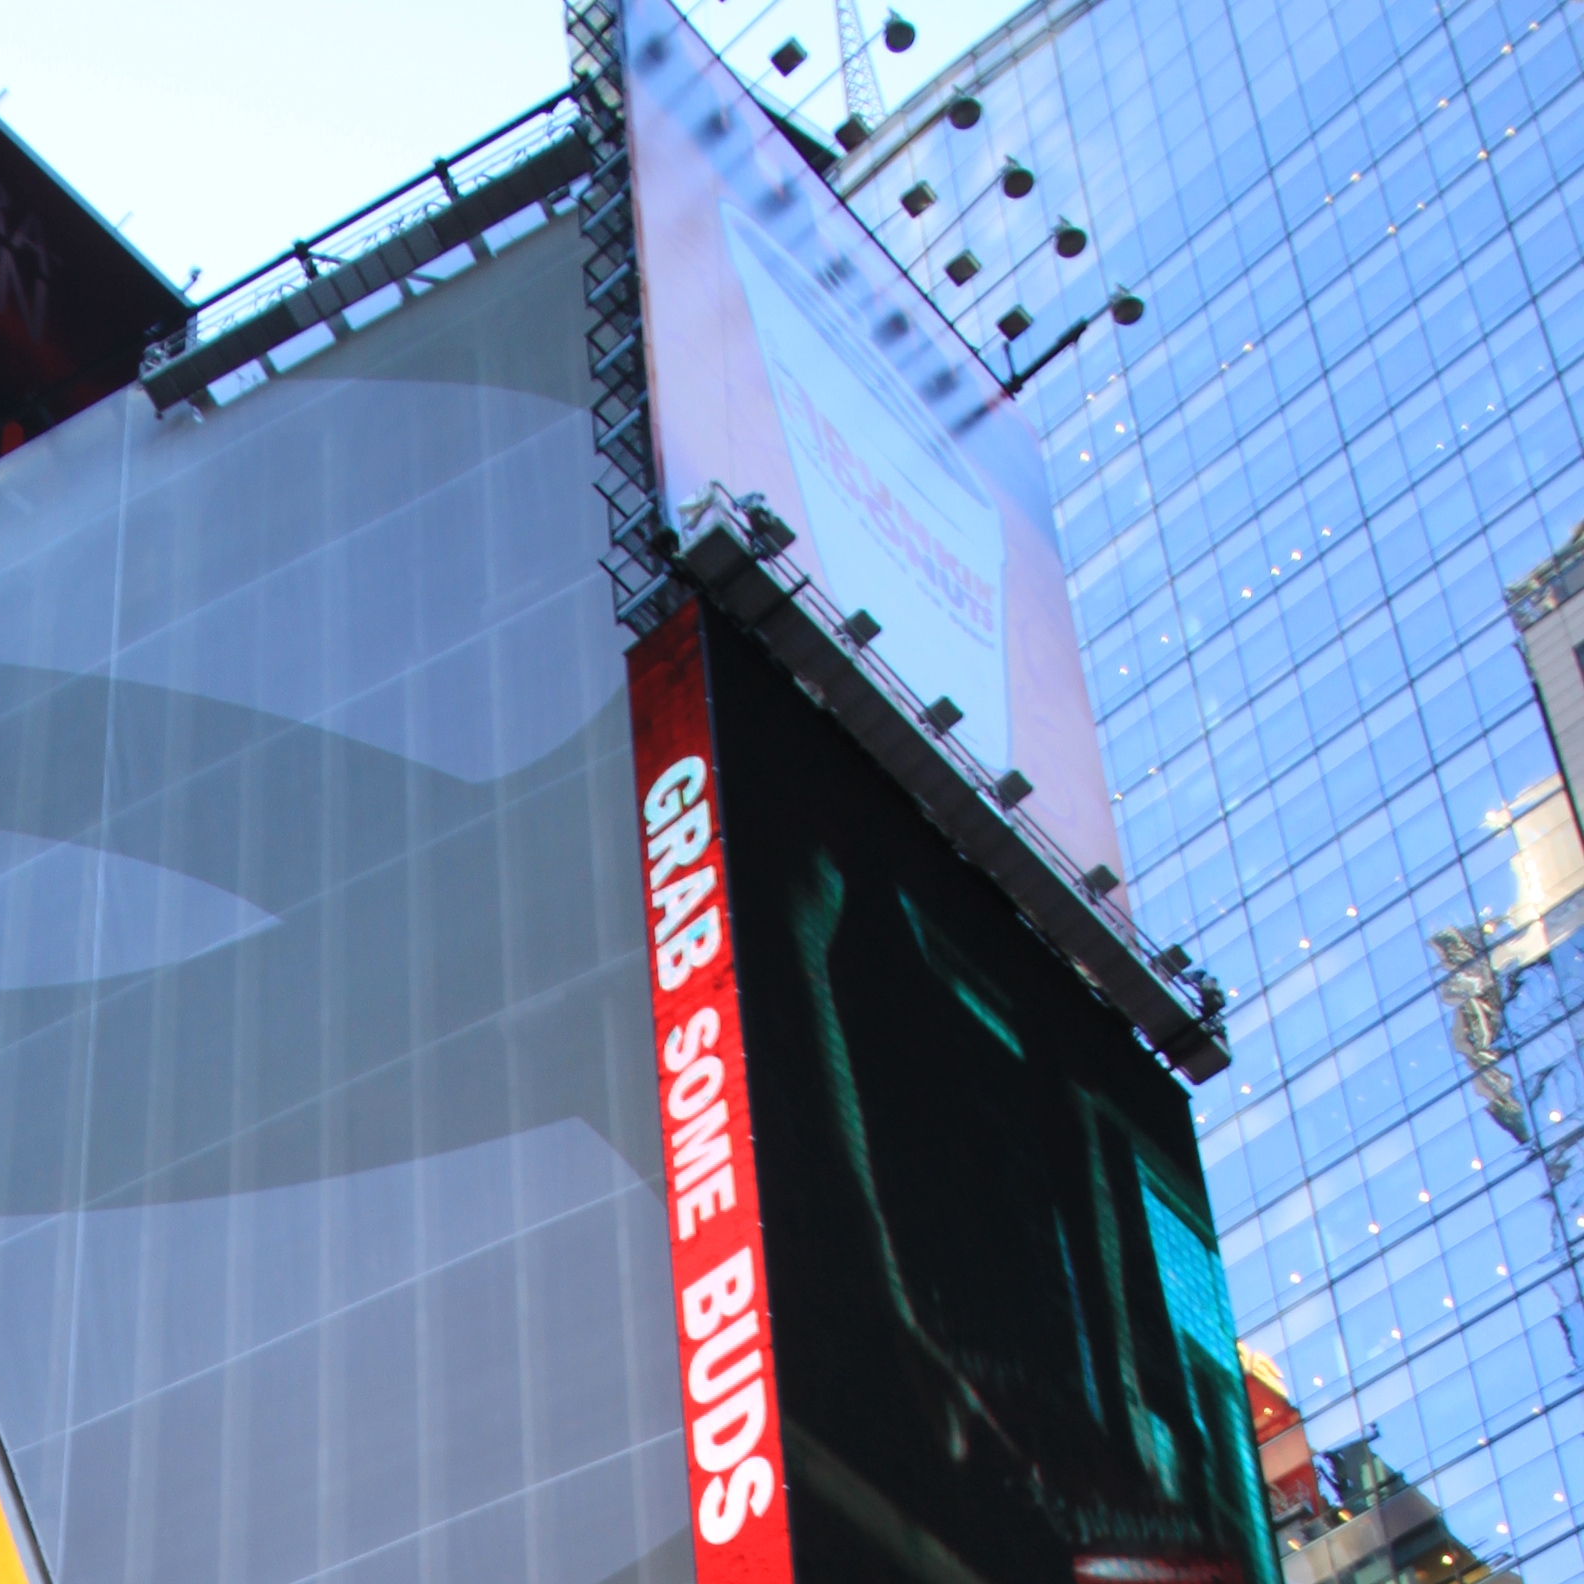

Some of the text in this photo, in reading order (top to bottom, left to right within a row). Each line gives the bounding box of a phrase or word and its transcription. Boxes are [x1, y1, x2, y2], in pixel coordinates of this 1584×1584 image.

[642, 754, 774, 1548] GRAB SOME BUDS
